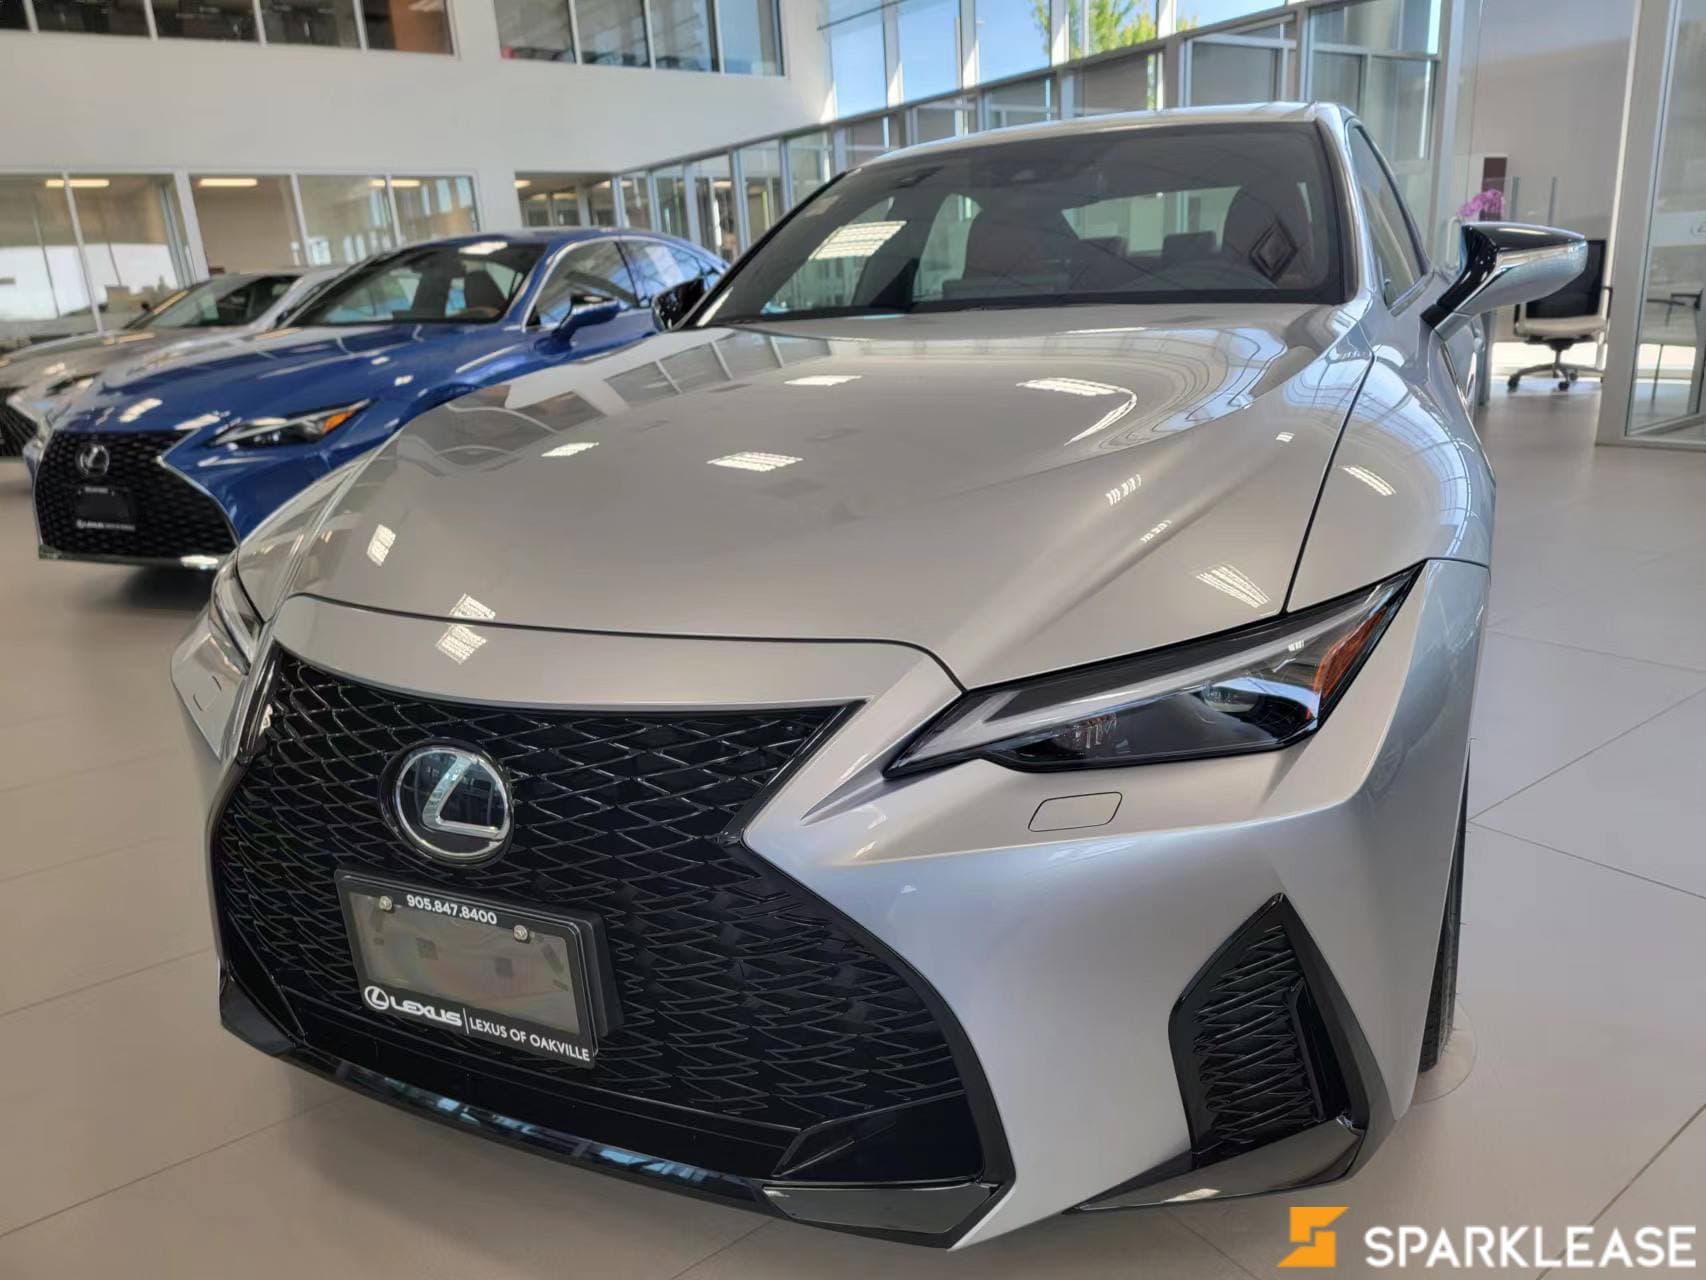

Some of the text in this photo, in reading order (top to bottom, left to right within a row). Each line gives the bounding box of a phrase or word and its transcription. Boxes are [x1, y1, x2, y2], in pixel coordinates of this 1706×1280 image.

[406, 894, 497, 924] 905.847.8400
[391, 997, 462, 1026] LEXUS
[469, 1017, 590, 1061] LEXUS OF OAKVILLE
